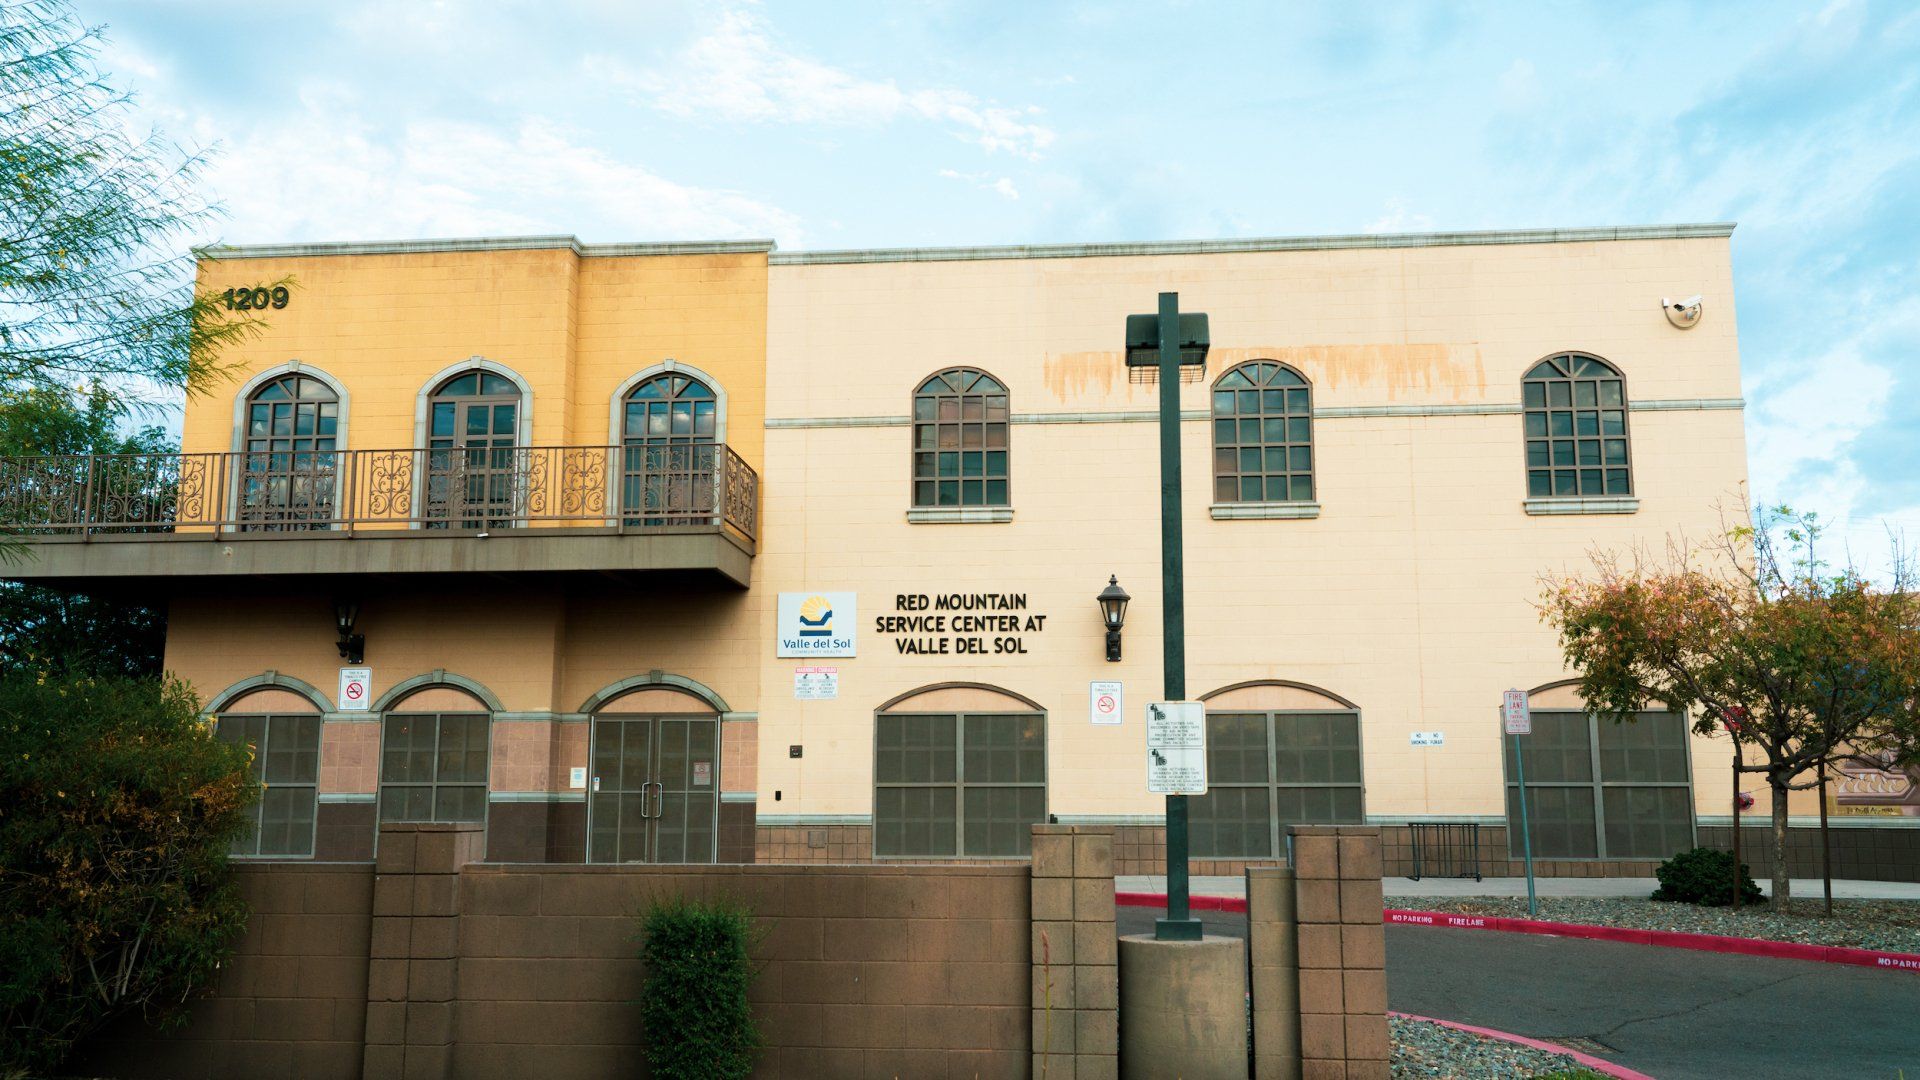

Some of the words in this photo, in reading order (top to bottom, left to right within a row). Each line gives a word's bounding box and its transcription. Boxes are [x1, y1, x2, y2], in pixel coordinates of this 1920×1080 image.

[223, 286, 289, 310] 1209
[896, 594, 929, 611] RED
[935, 593, 1027, 610] MOUNTAIN
[876, 616, 946, 633] SERVICE
[951, 615, 1020, 632] CENTER
[1024, 615, 1047, 632] AT
[783, 639, 811, 649] Valle
[813, 638, 830, 649] del
[833, 638, 851, 649] Sol
[896, 638, 949, 655] VALLE
[956, 637, 989, 654] DEL
[994, 637, 1027, 654] SOL
[1403, 915, 1433, 924] PARKING
[1466, 918, 1485, 926] LANE
[1878, 957, 1891, 966] NO
